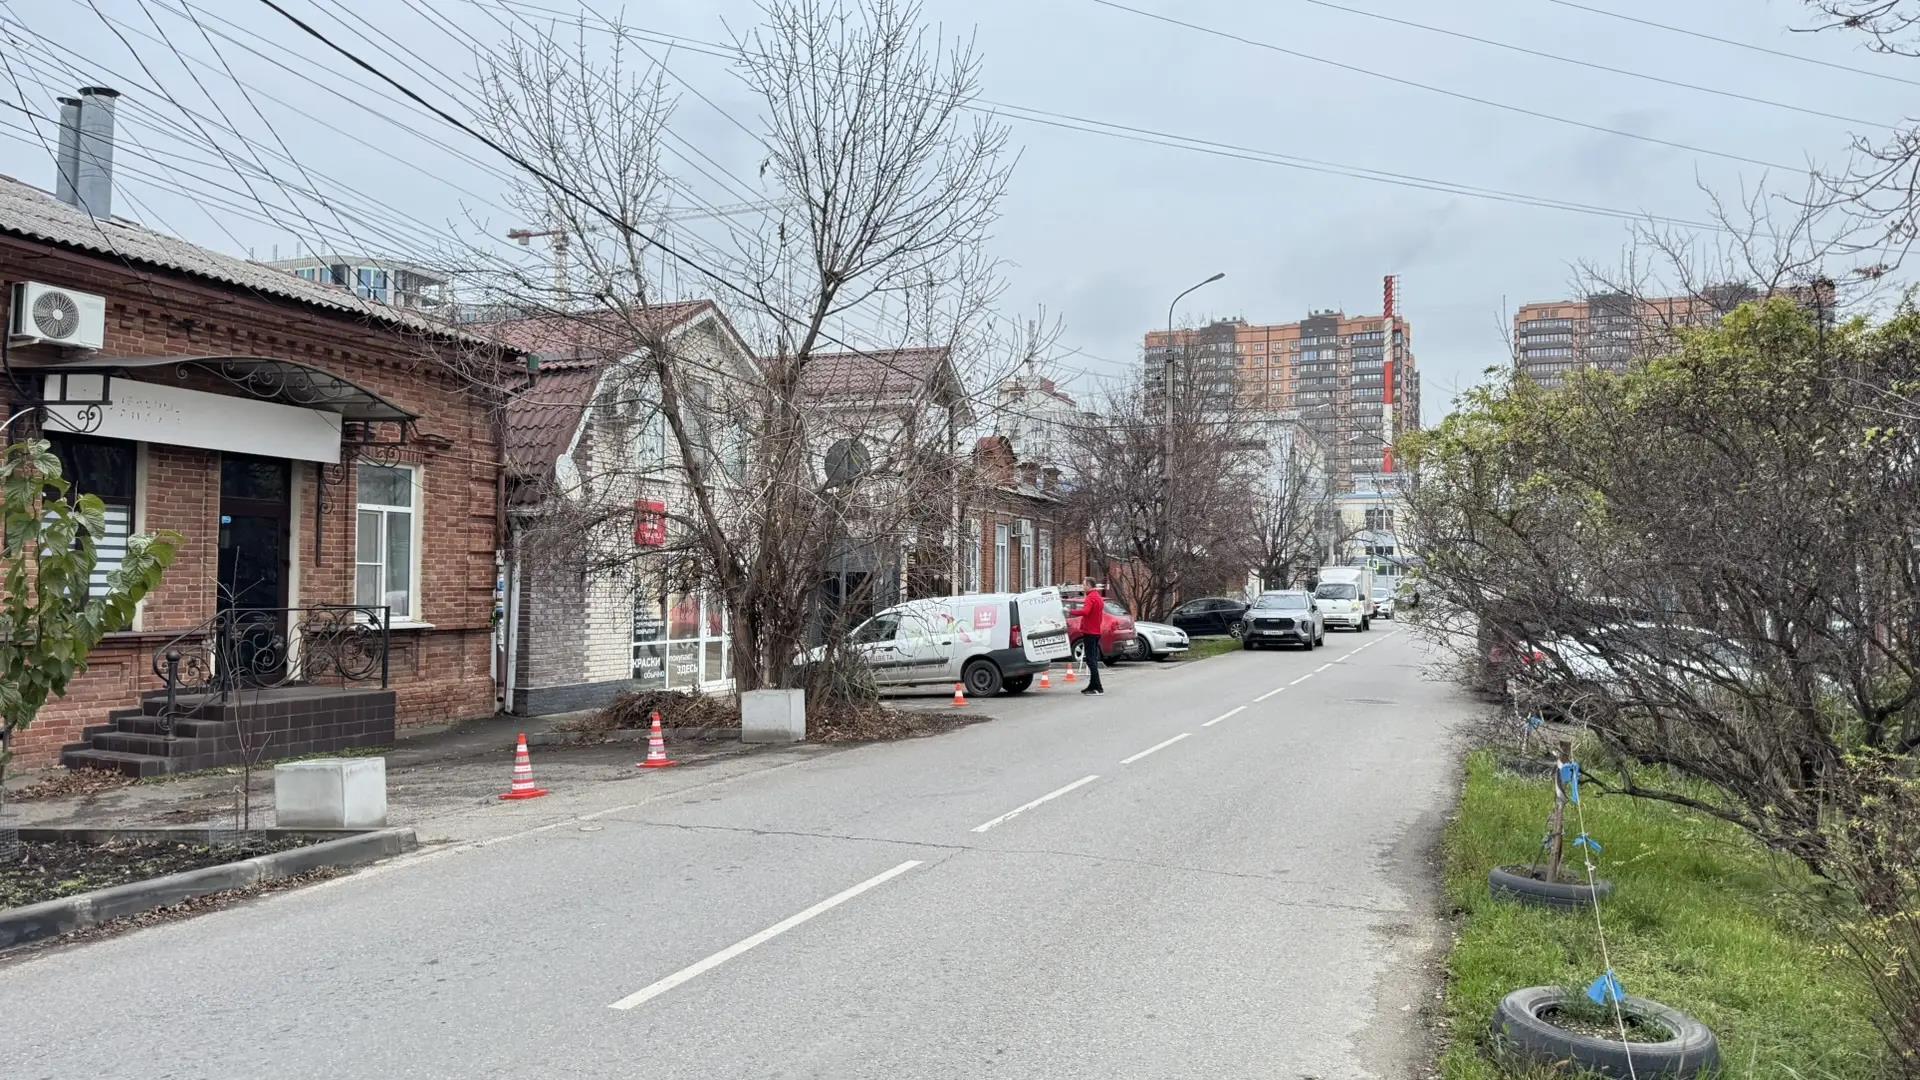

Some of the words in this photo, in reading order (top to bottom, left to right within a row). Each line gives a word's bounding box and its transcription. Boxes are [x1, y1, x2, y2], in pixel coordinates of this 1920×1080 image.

[632, 657, 660, 668] КРАСКИ
[644, 670, 664, 679] обычно
[677, 664, 698, 675] ЗДЕСЬ
